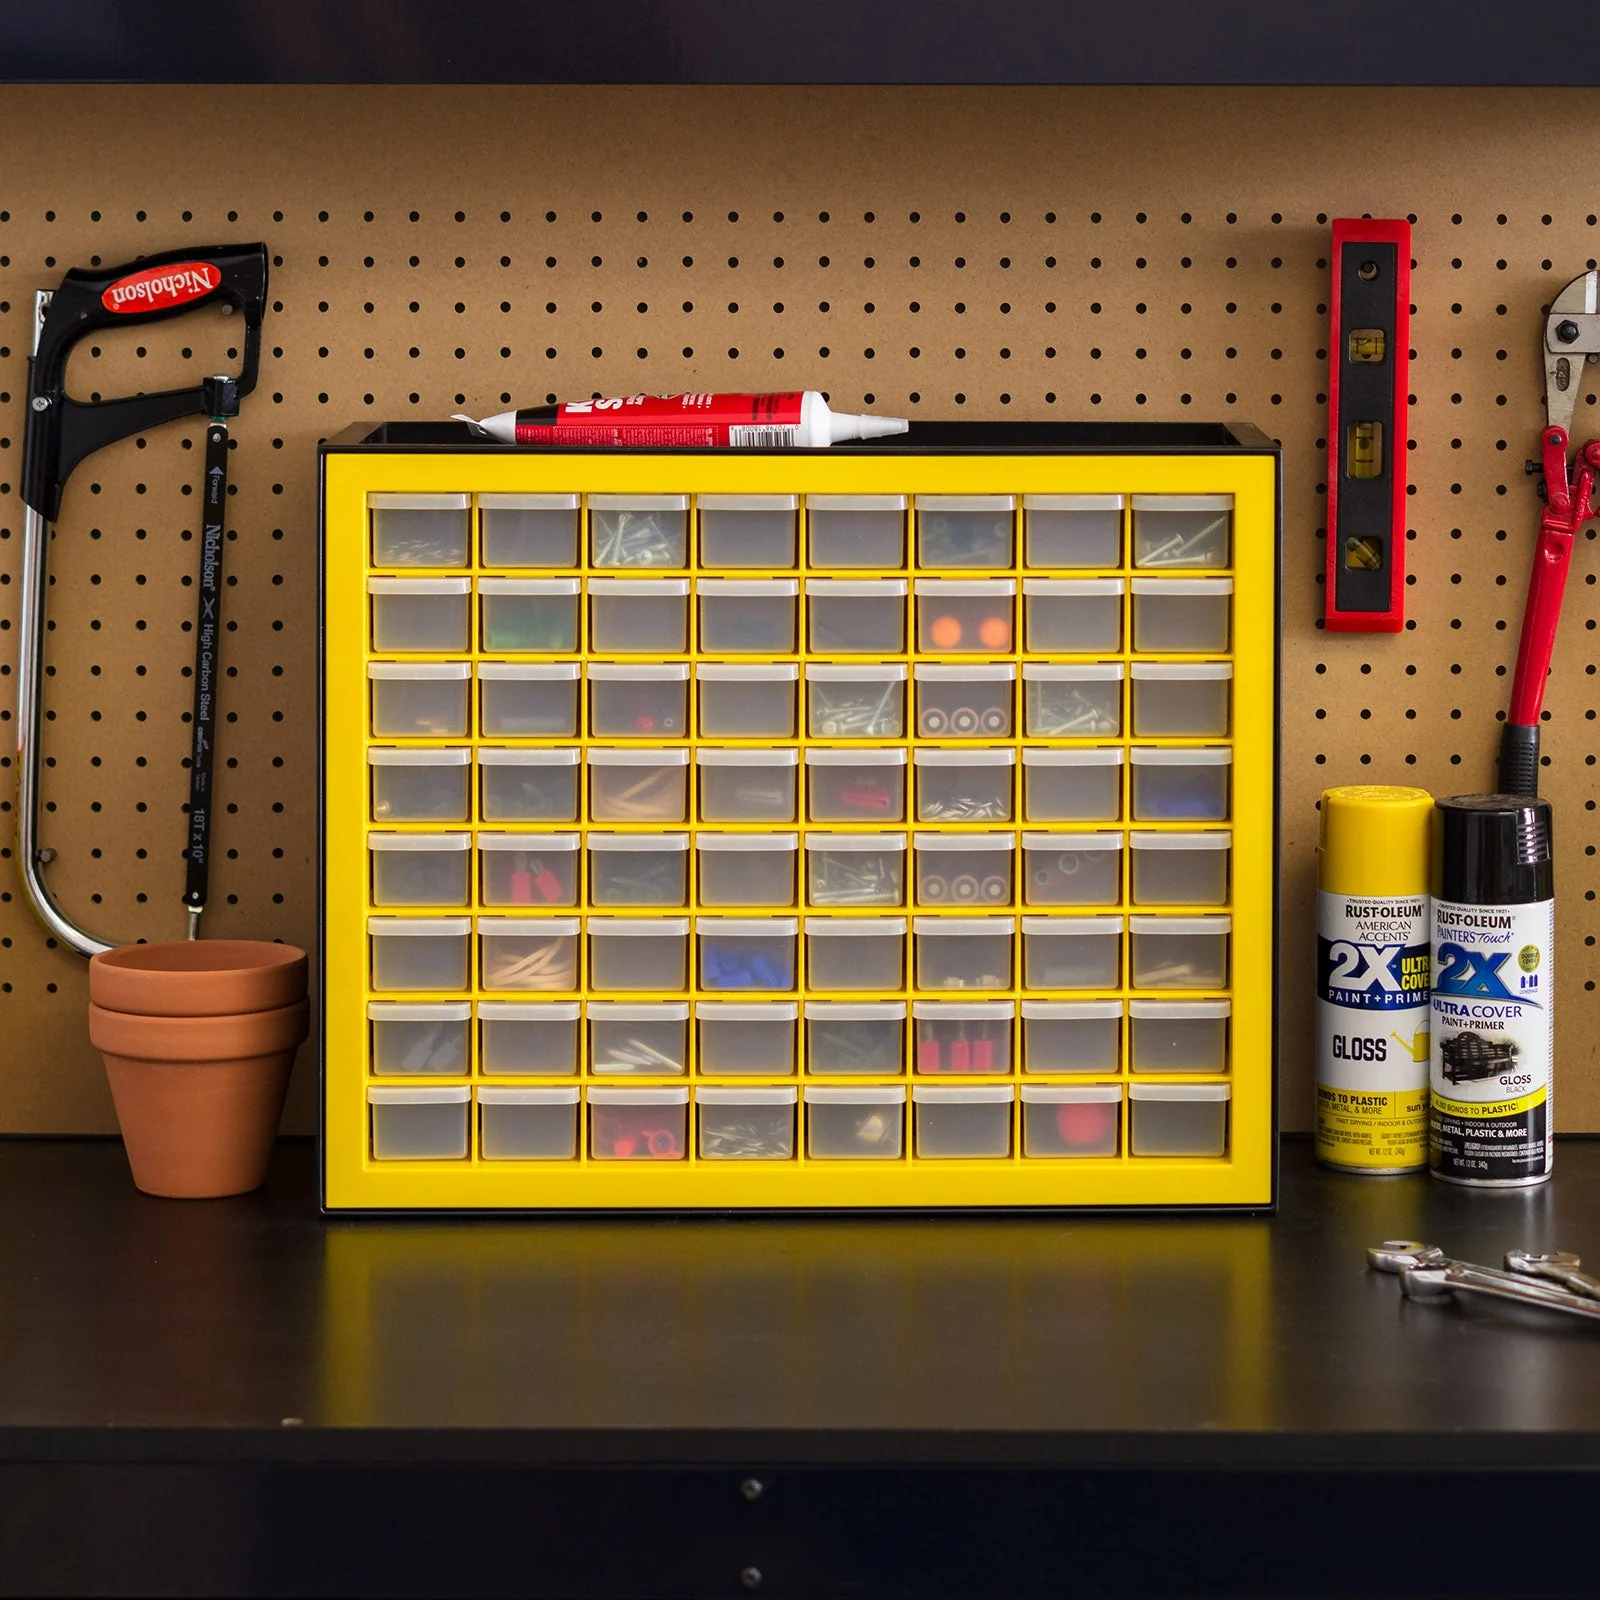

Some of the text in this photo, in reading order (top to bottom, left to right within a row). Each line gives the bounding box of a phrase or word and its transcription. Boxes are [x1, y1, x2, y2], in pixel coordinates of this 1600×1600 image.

[112, 267, 213, 303] Nicholson
[211, 475, 220, 504] Forward
[203, 524, 220, 587] Nicholson
[199, 624, 213, 721] High Carbon Steel
[193, 807, 205, 830] 18T
[192, 833, 201, 841] x
[1457, 905, 1477, 913] QUALITY
[1355, 920, 1412, 931] AMERICAN
[1437, 910, 1511, 929] RUST-OLEUM
[1358, 931, 1409, 941] ACCENTS
[1437, 925, 1511, 943] PAINTER'S Touch
[1329, 942, 1402, 992] 2X
[1401, 956, 1429, 974] ULTR
[1437, 942, 1513, 997] 2X
[1401, 973, 1429, 991] COVE
[1433, 998, 1523, 1018] ULTRA COVER
[1332, 1034, 1387, 1062] GLOSS
[1499, 1074, 1532, 1085] GLOSS
[1338, 1094, 1348, 1104] TO
[1350, 1095, 1388, 1106] PLASTIC
[1406, 1104, 1421, 1112] sun
[1447, 1103, 1469, 1114] BONDS
[1469, 1106, 1480, 1115] TO
[1354, 1106, 1360, 1114] &
[1362, 1106, 1383, 1115] MORE
[1443, 1125, 1465, 1136] METAL,
[1465, 1128, 1497, 1138] PLASTIC
[1498, 1129, 1504, 1138] &
[1506, 1128, 1528, 1138] MORE
